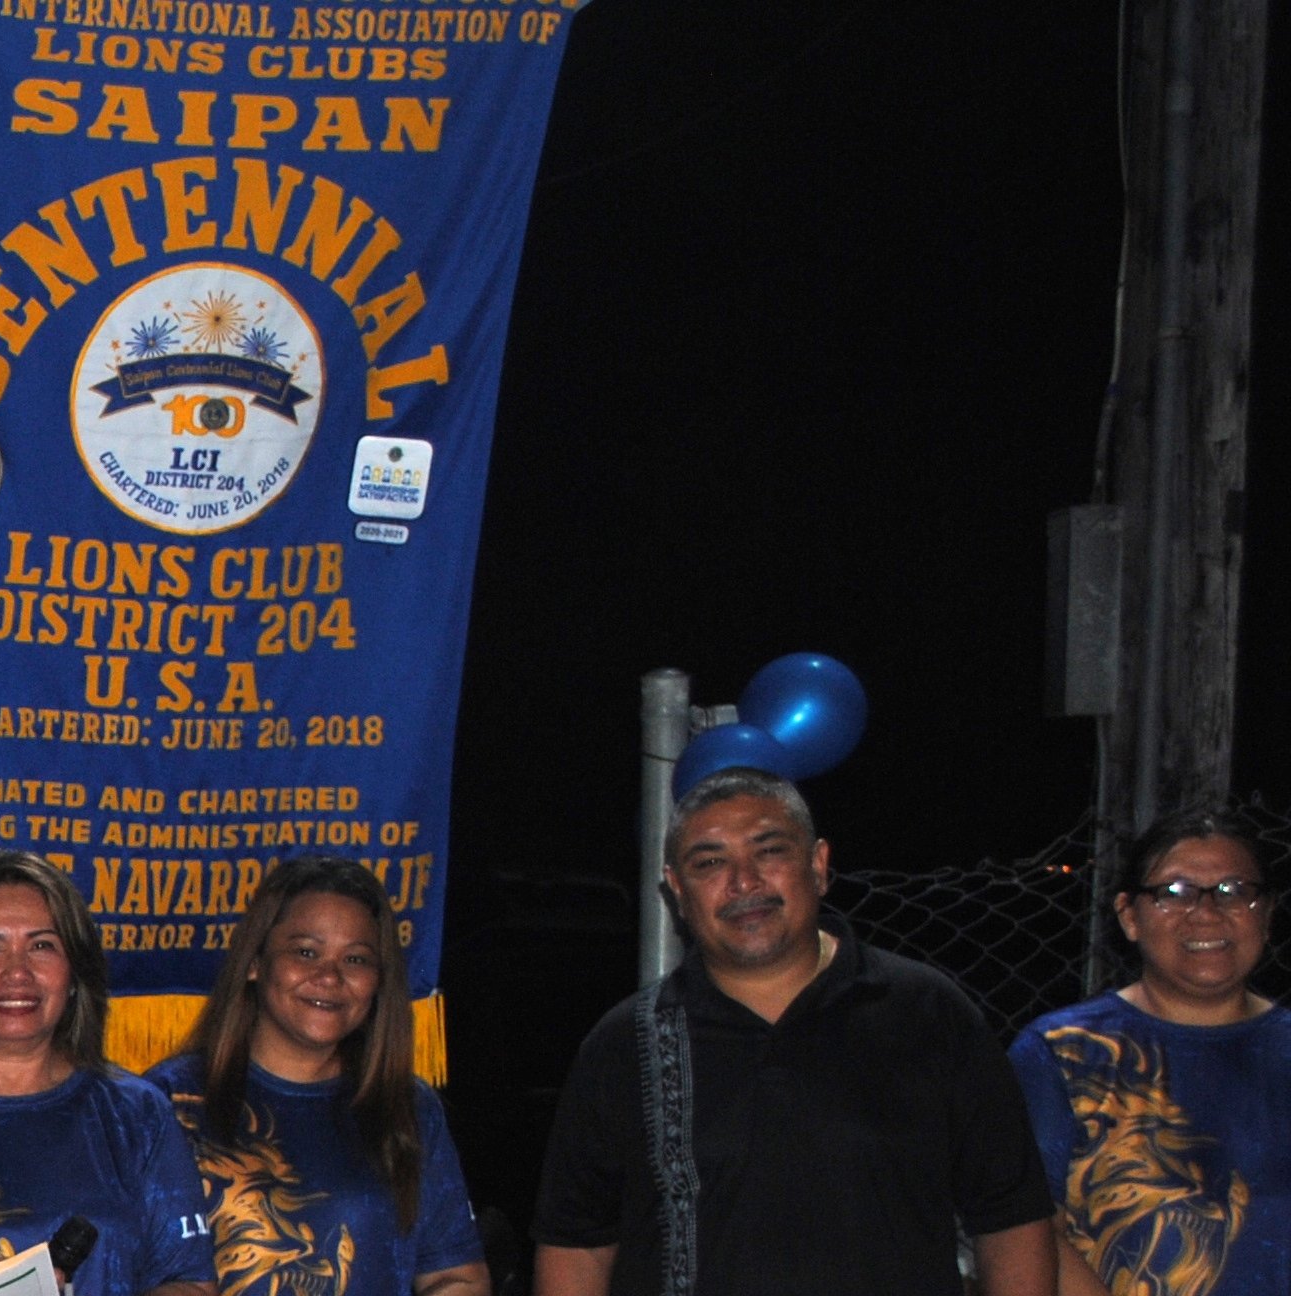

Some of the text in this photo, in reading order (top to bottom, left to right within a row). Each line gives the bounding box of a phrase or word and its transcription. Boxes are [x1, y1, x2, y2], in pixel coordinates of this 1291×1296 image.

[288, 7, 511, 43] ASSOCIATION
[519, 10, 562, 45] OF
[31, 27, 448, 81] LIONS CLUBS
[10, 78, 451, 152] SAIPAN
[170, 447, 221, 473] LCI
[99, 451, 290, 520] CHARTERED: JUNE 20, 2018
[145, 470, 246, 492] DISTRICT 204
[4, 531, 343, 600] LIONS CLUB
[256, 597, 357, 656] 204
[160, 718, 244, 750] JUNE
[256, 717, 297, 749] 20,
[305, 714, 385, 747] 2018
[98, 785, 166, 814] AND
[177, 786, 360, 815] CHARTERED
[26, 815, 92, 844] THE
[102, 819, 371, 850] ADMINISTRATION
[379, 821, 419, 847] OF
[88, 856, 279, 917] NAVARR
[94, 922, 196, 952] ERNOR
